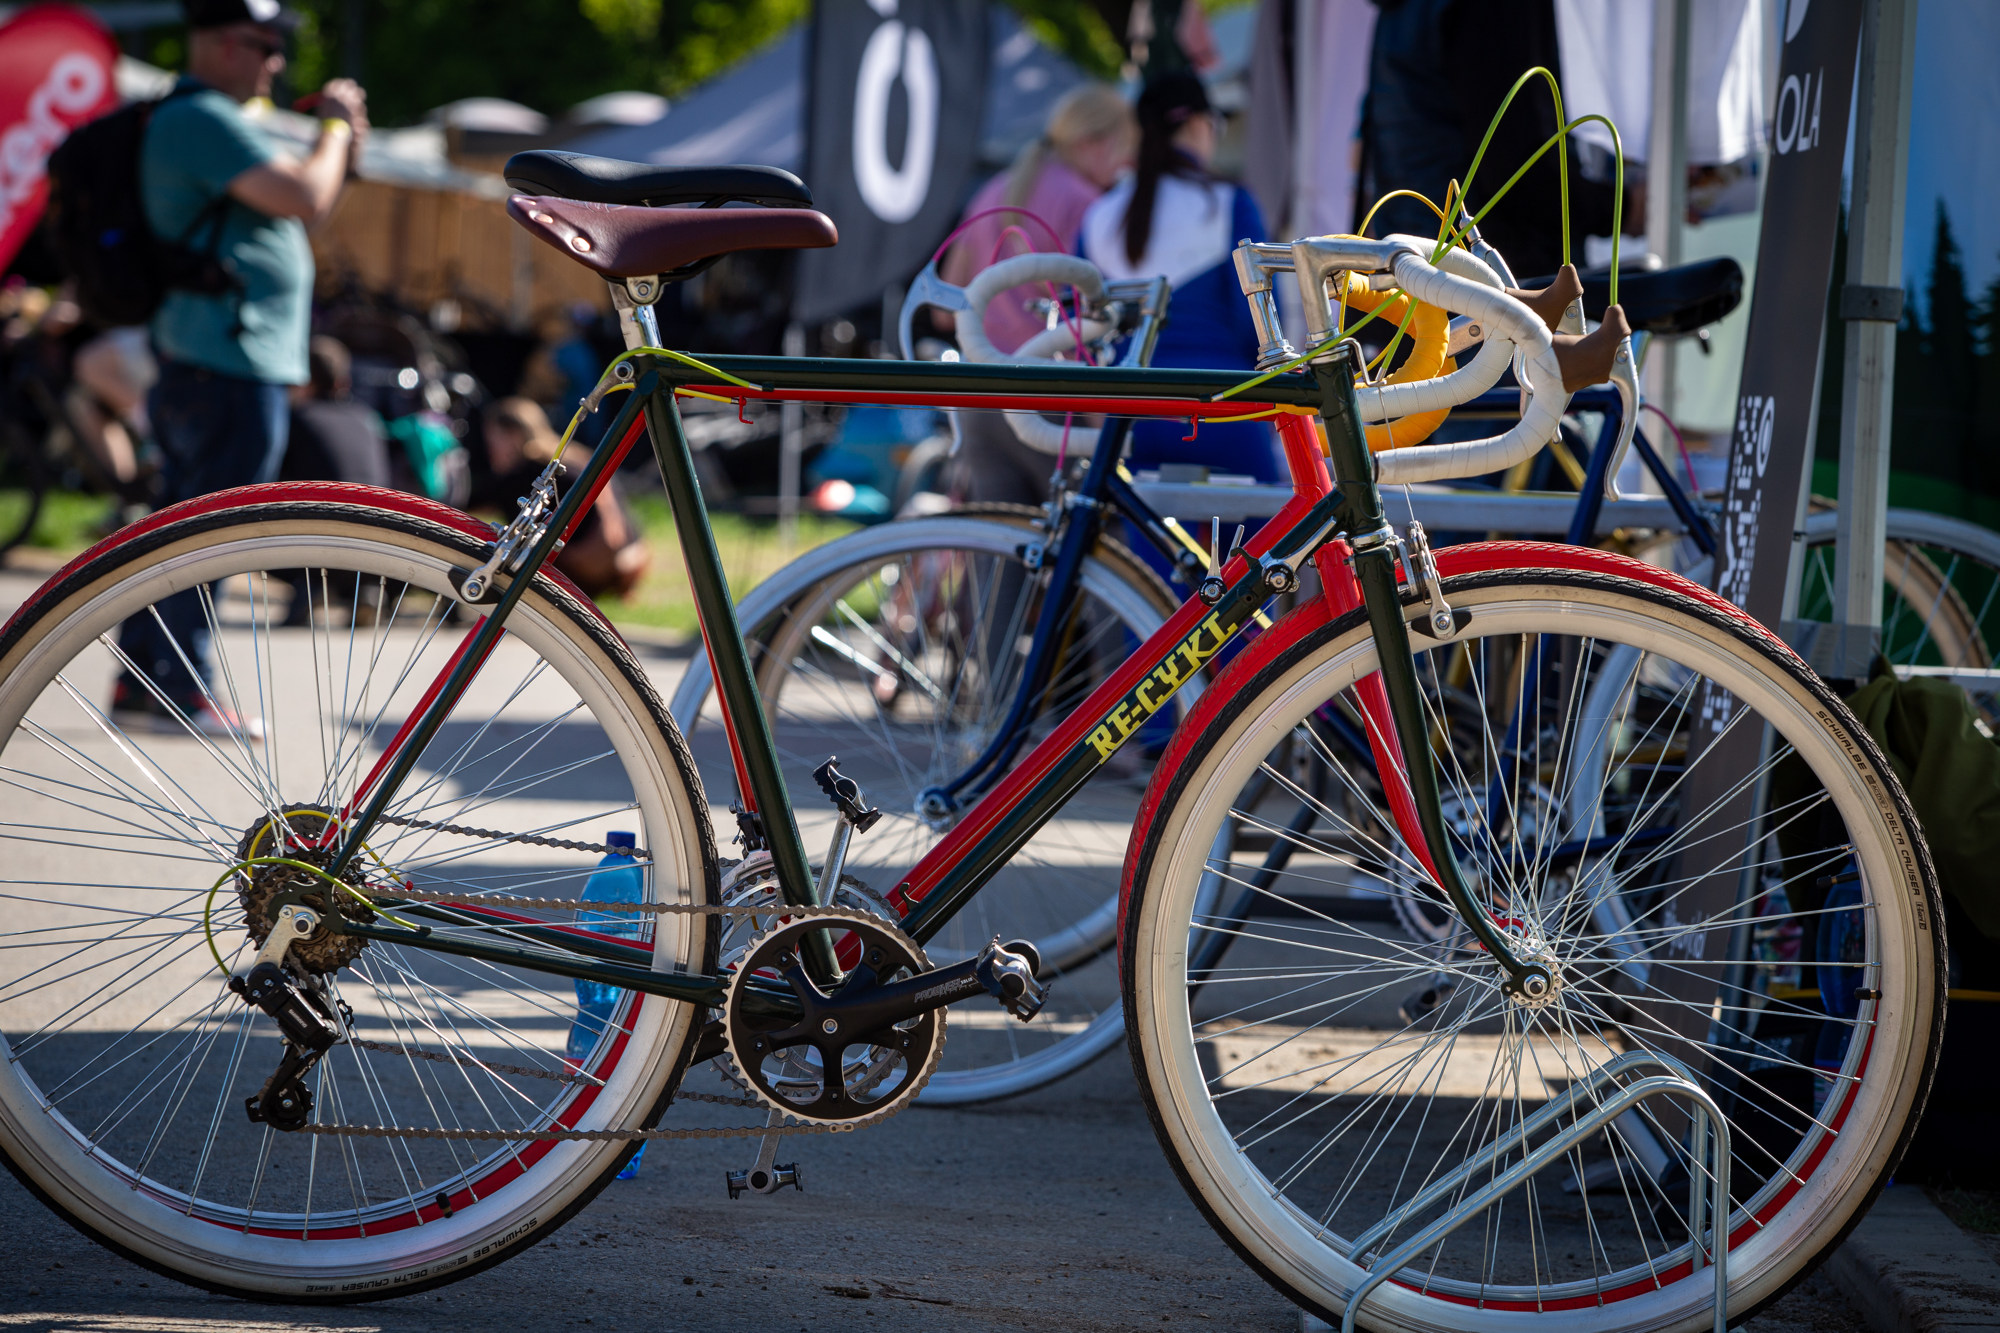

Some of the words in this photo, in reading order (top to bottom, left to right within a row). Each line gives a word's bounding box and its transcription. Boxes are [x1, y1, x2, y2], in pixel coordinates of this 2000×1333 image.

[1773, 66, 1824, 155] OLA
[1085, 611, 1238, 764] RE-CYKL
[1816, 710, 1867, 770] SCHWALBE
[1885, 812, 1905, 845] DELTA
[1901, 849, 1920, 896] CRUISER
[473, 1217, 538, 1259] SCHWALBE
[342, 1278, 389, 1292] CRUISER
[394, 1269, 428, 1283] DELTA
